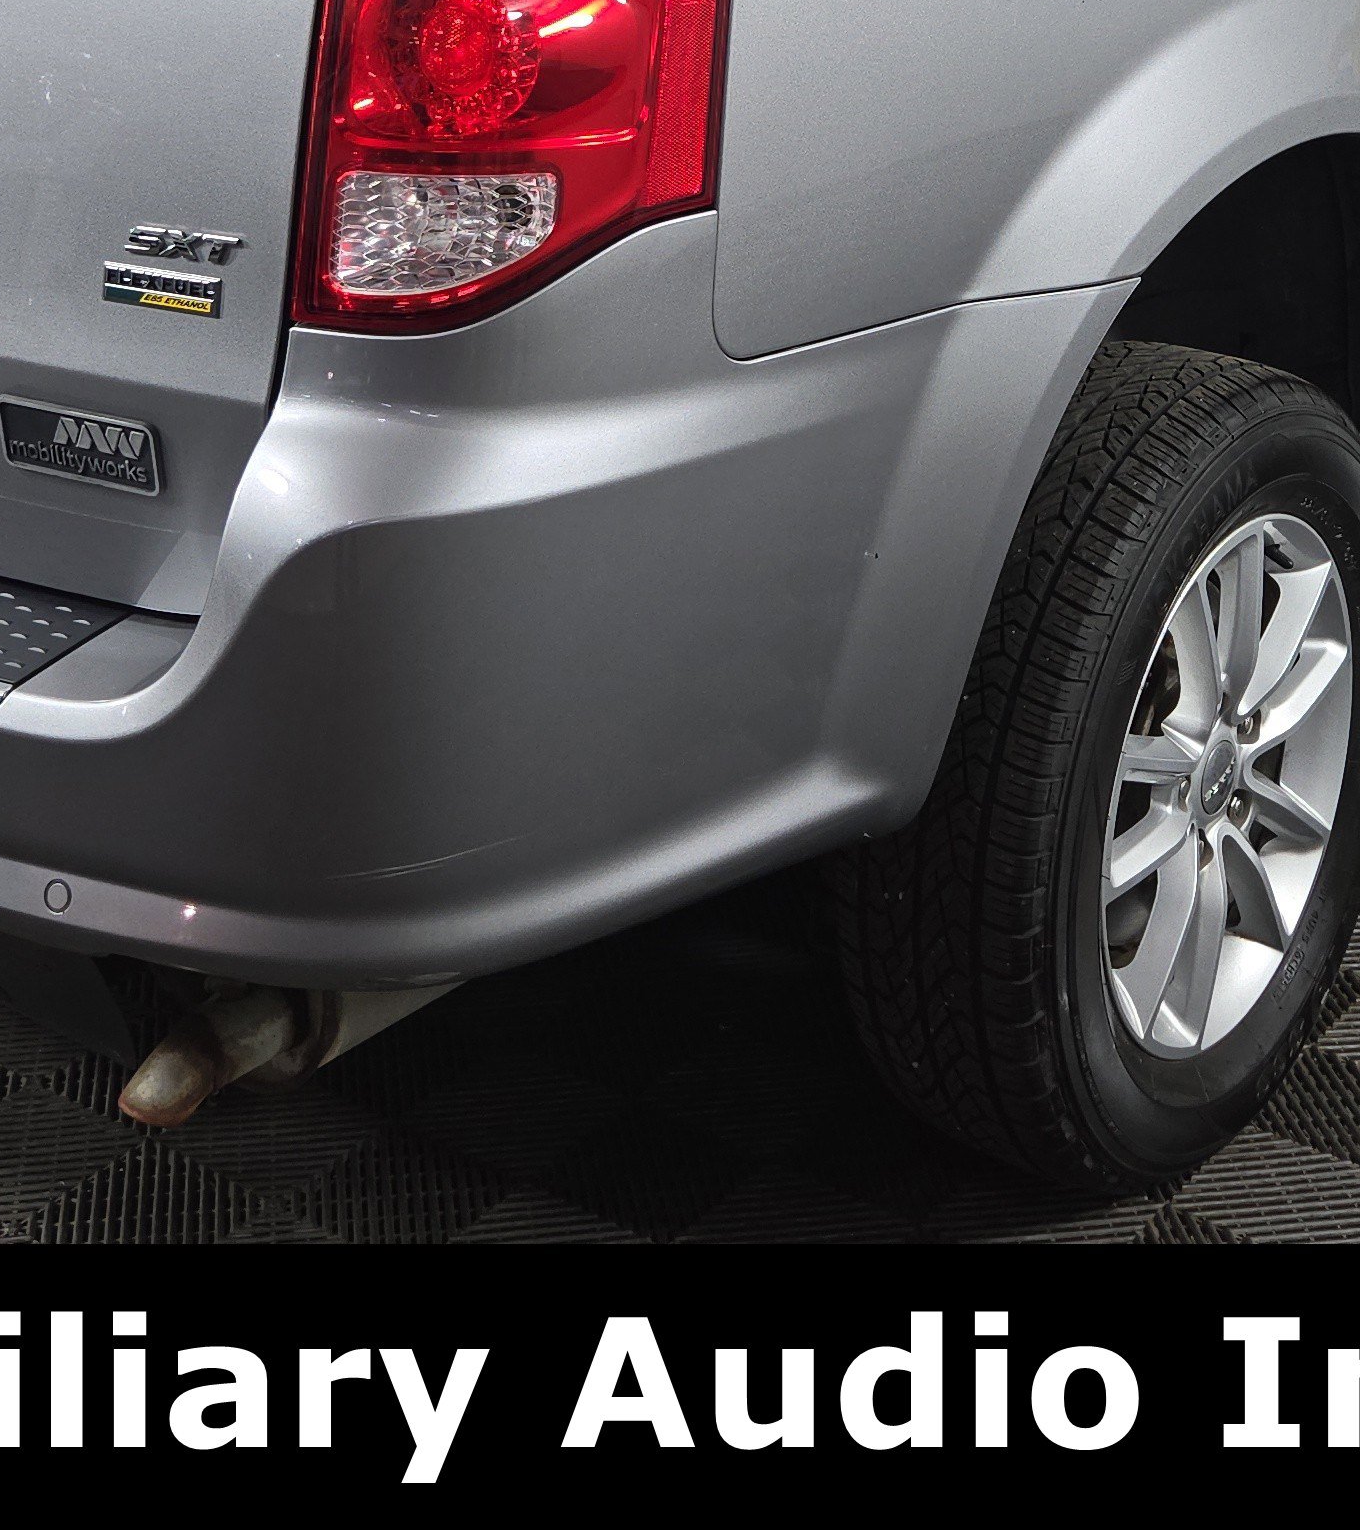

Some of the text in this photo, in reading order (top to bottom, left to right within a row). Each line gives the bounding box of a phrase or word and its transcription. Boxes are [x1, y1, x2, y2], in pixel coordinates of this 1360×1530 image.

[124, 225, 241, 266] SXT
[143, 293, 210, 311] E85 ETHANOL
[8, 439, 148, 483] mobilityworks
